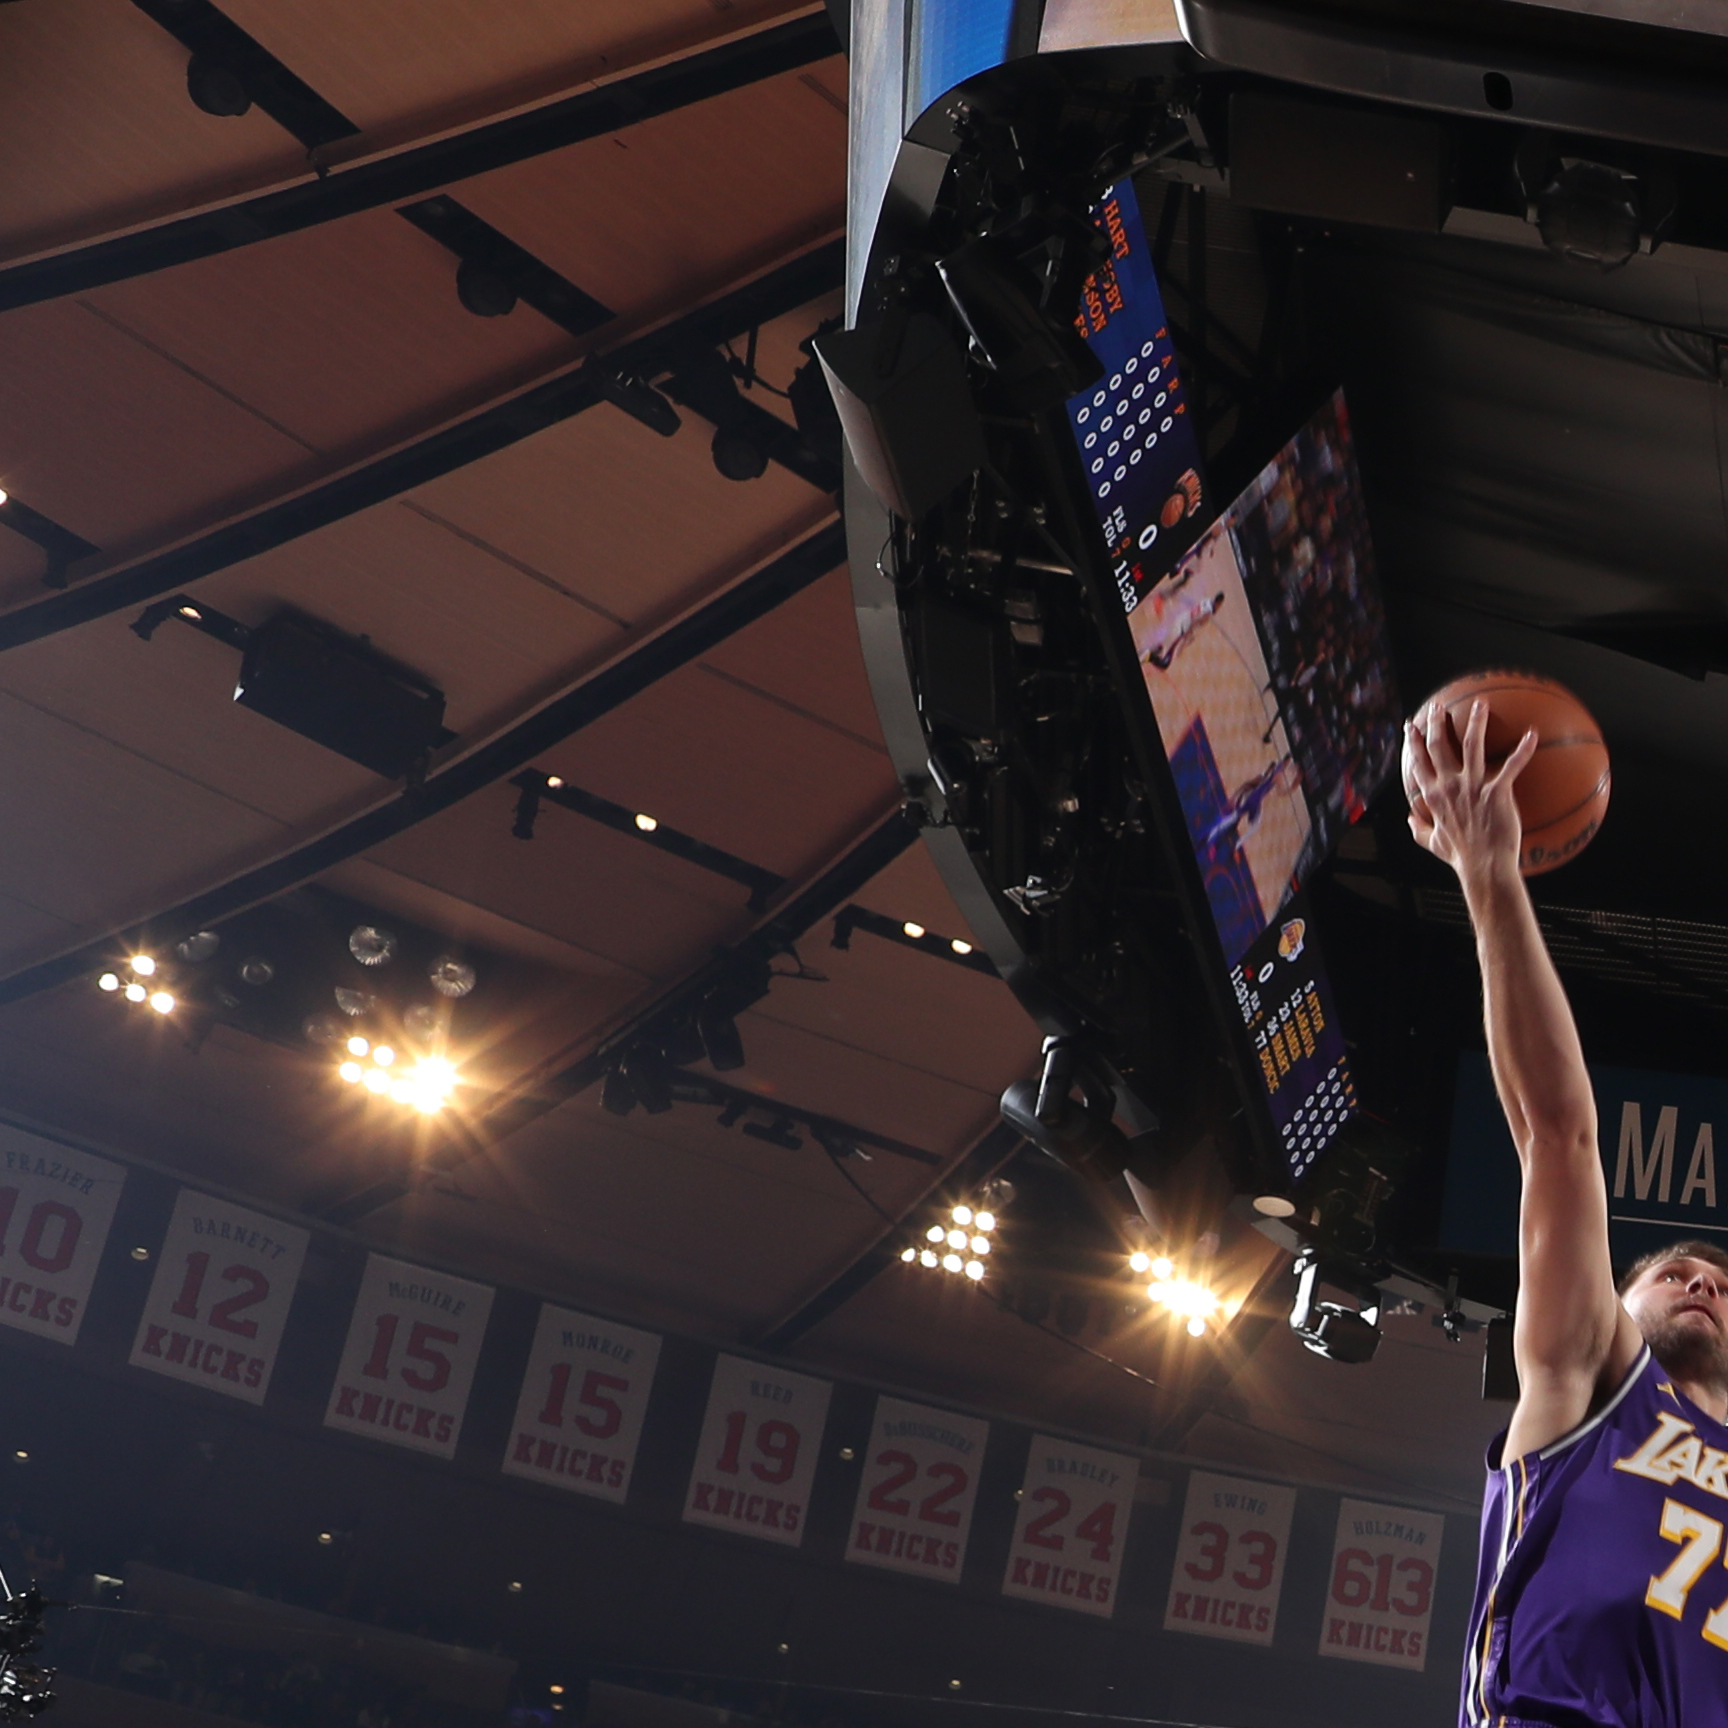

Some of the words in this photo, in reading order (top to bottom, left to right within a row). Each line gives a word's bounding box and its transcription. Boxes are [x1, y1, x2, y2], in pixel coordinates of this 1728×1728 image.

[1103, 199, 1130, 259] HART
[1102, 516, 1117, 547] TOL
[1113, 505, 1127, 532] FLS
[1138, 524, 1158, 550] 0
[1114, 560, 1138, 613] 11:33
[6, 1152, 95, 1196] FRAZIER
[192, 1216, 286, 1260] BARNETT
[171, 1250, 270, 1340] 12
[142, 1323, 266, 1388] KNICKS
[362, 1313, 460, 1393] 15
[335, 1386, 455, 1444] KNICKS
[538, 1362, 630, 1440] 15
[513, 1432, 626, 1489] KNICKS
[716, 1411, 800, 1484] 19
[1045, 1456, 1120, 1490] BRADLEY
[692, 1482, 800, 1532] KNICKS
[867, 1450, 968, 1528] 22
[1214, 1493, 1268, 1516] EWING
[855, 1522, 960, 1569] KNICKS
[1023, 1486, 1116, 1563] 24
[1353, 1520, 1428, 1546] HOLZMAN
[1011, 1556, 1111, 1604] KNICKS
[1184, 1521, 1278, 1591] 33
[1331, 1548, 1434, 1618] 613
[1172, 1592, 1271, 1633] KNICKS
[1327, 1618, 1423, 1657] KNICKS
